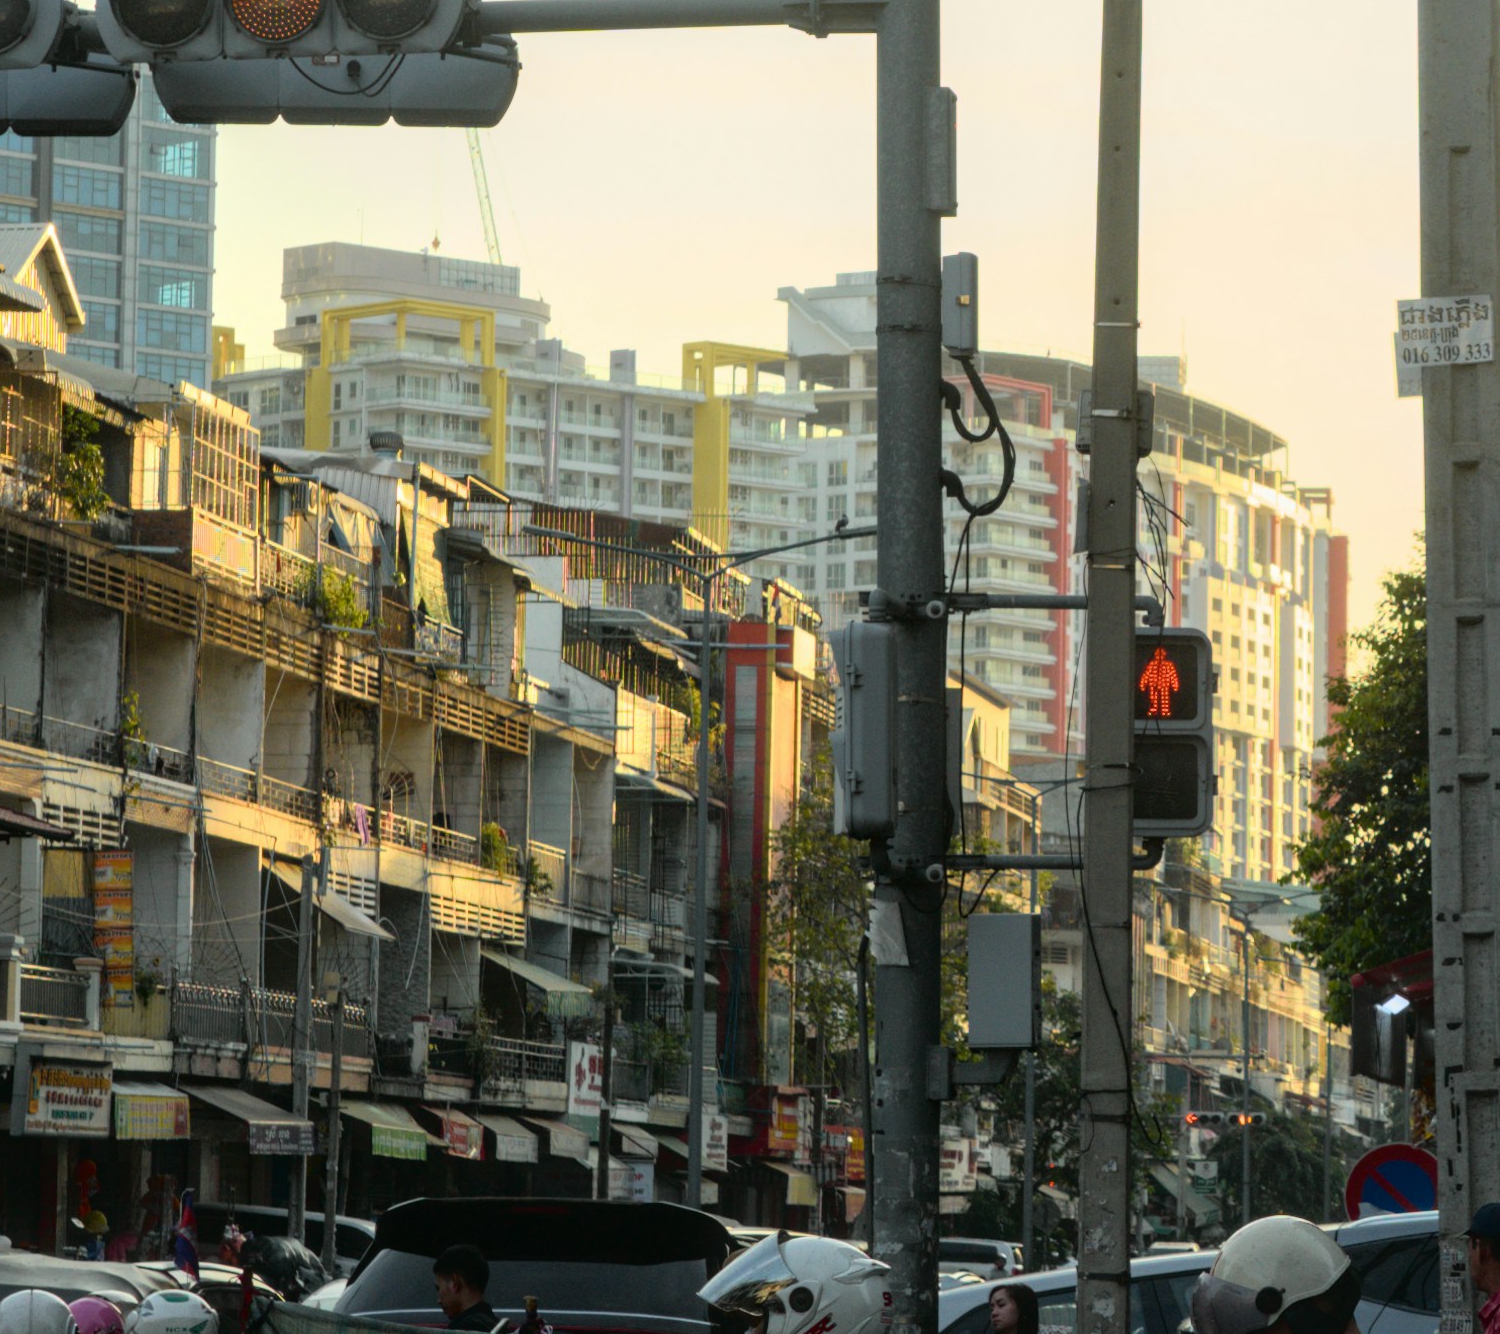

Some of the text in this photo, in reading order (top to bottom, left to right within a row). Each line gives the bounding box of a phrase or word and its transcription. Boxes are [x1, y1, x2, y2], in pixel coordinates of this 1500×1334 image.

[1402, 342, 1491, 365] 016 309 333
